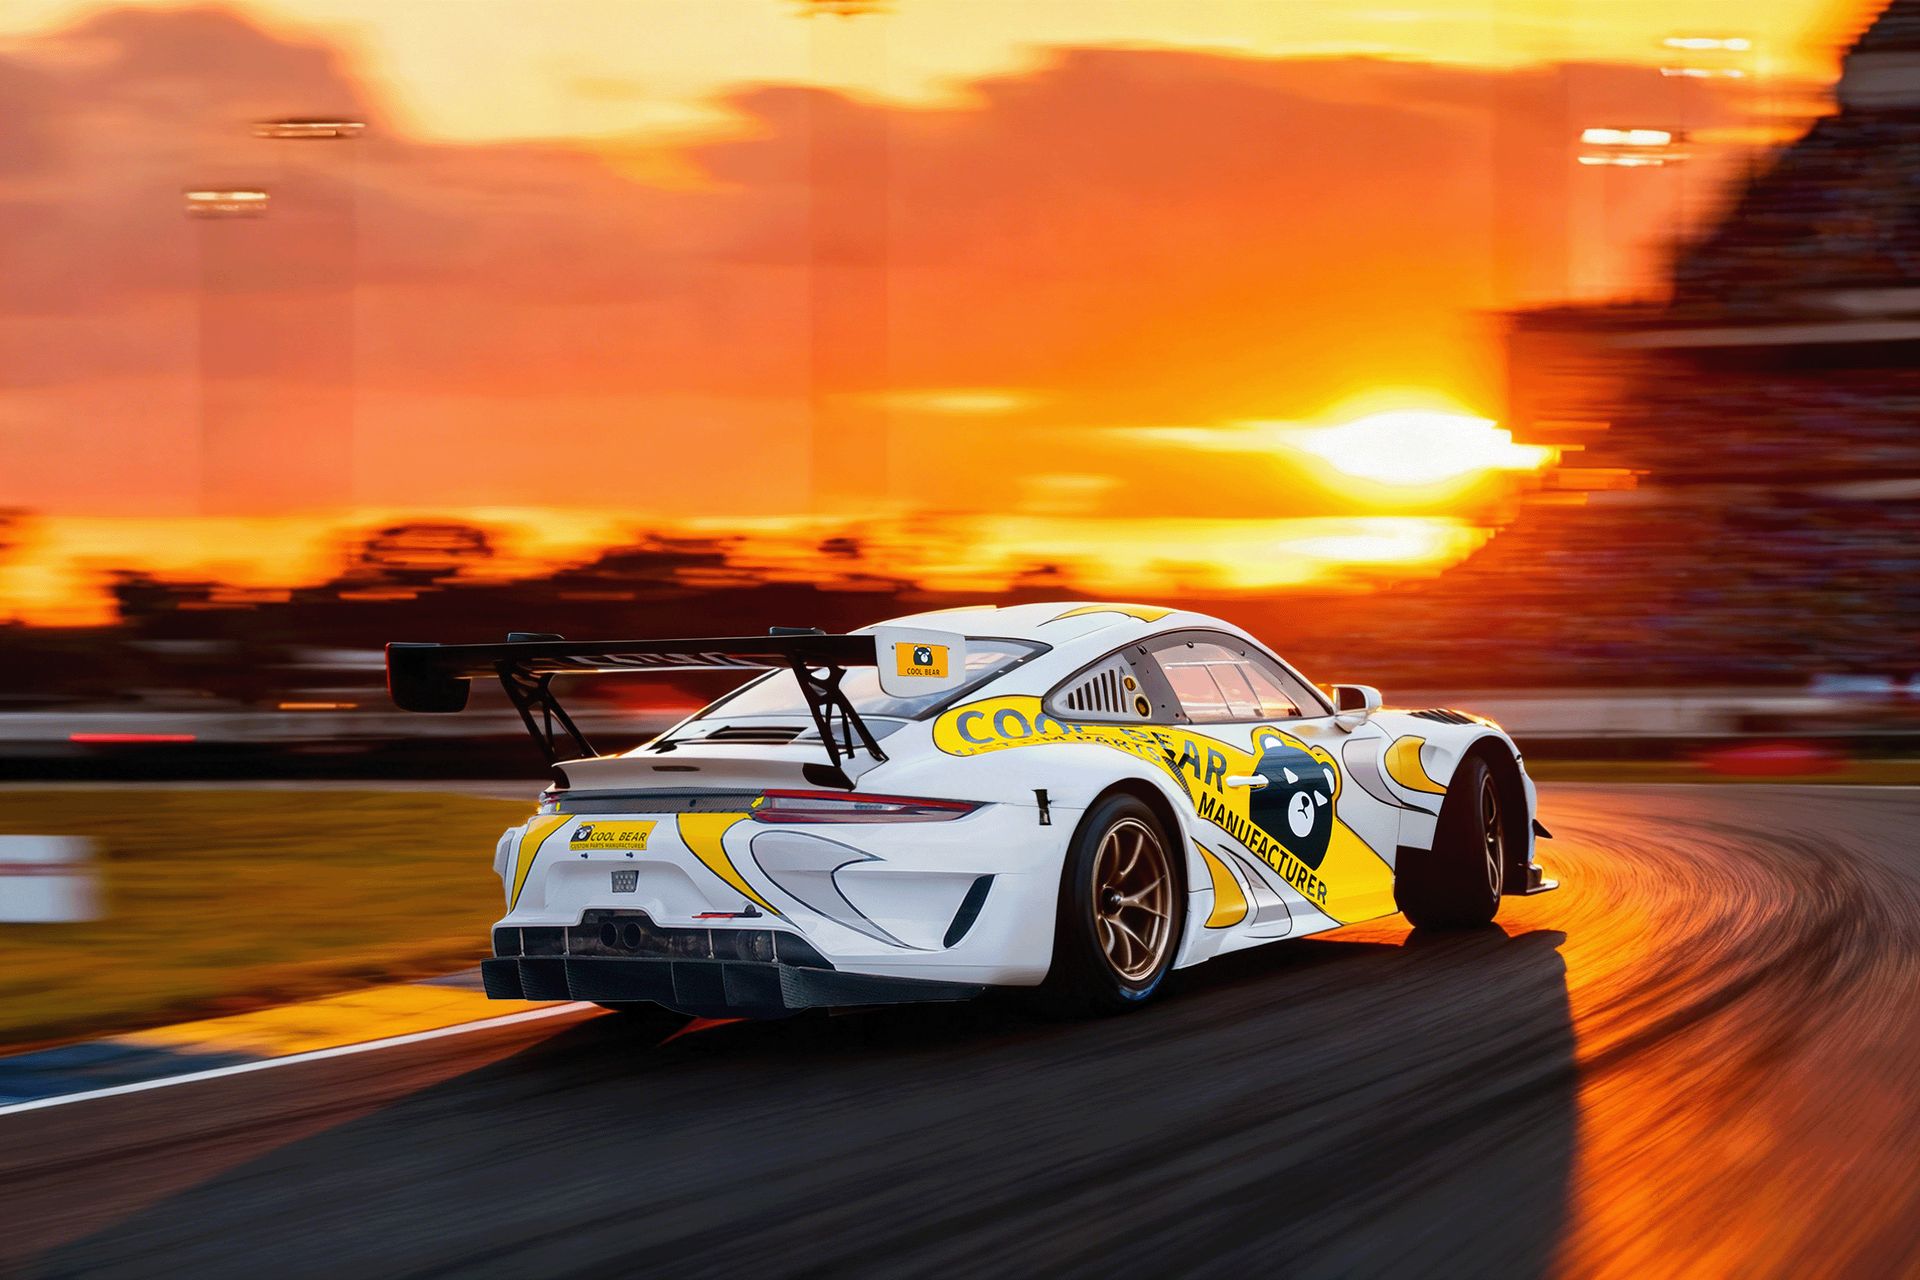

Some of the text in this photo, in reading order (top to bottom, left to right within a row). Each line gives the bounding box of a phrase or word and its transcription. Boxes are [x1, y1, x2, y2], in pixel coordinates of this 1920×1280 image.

[907, 667, 940, 676] COOL BEAR
[1119, 728, 1227, 795] BEAR
[1074, 734, 1161, 762] PARTS
[1197, 791, 1328, 905] MANUFACTURER
[590, 831, 647, 842] COOL BEAR
[570, 842, 589, 850] CUSTOM
